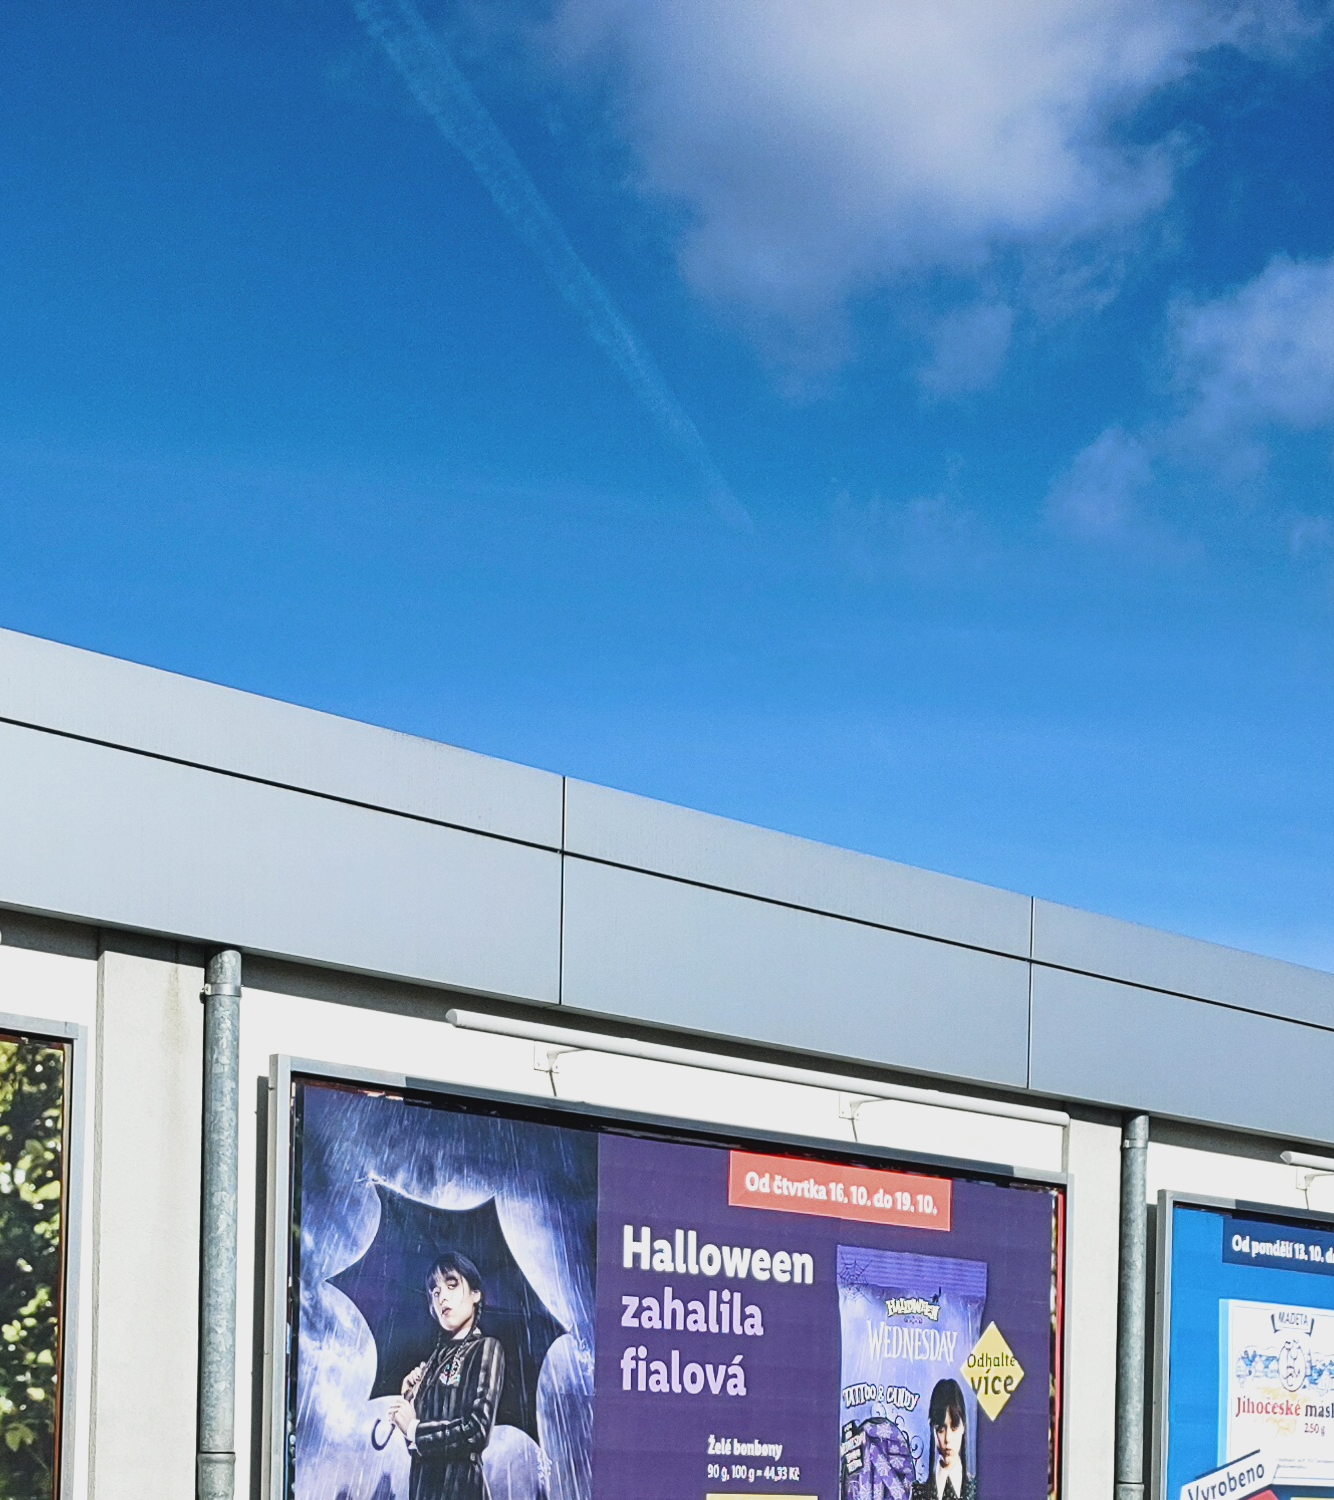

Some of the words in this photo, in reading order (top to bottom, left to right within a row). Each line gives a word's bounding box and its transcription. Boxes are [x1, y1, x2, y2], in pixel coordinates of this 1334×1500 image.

[746, 1171, 770, 1194] Od
[773, 1175, 827, 1201] čtvrtka
[829, 1182, 848, 1204] 16.
[850, 1186, 871, 1207] 10.
[874, 1188, 893, 1209] do
[896, 1191, 915, 1213] 19.
[917, 1195, 937, 1216] 10.
[623, 1225, 814, 1285] Halloween
[1232, 1234, 1250, 1253] Od
[1251, 1239, 1294, 1258] pondělí
[1309, 1245, 1325, 1263] 10.
[621, 1287, 765, 1336] zahalila
[1278, 1311, 1310, 1327] MADETA
[867, 1319, 958, 1364] WEDNESDAY
[620, 1346, 747, 1396] fialová
[967, 1352, 1015, 1368] Odhalte
[842, 1382, 877, 1408] TATTOO
[970, 1368, 1014, 1396] více
[1235, 1395, 1302, 1418] Jihočeské
[1304, 1422, 1320, 1434] 250
[708, 1434, 732, 1455] Želé
[733, 1438, 783, 1461] bonbony
[707, 1463, 720, 1478] 90
[731, 1464, 747, 1479] 100
[748, 1468, 755, 1482] g
